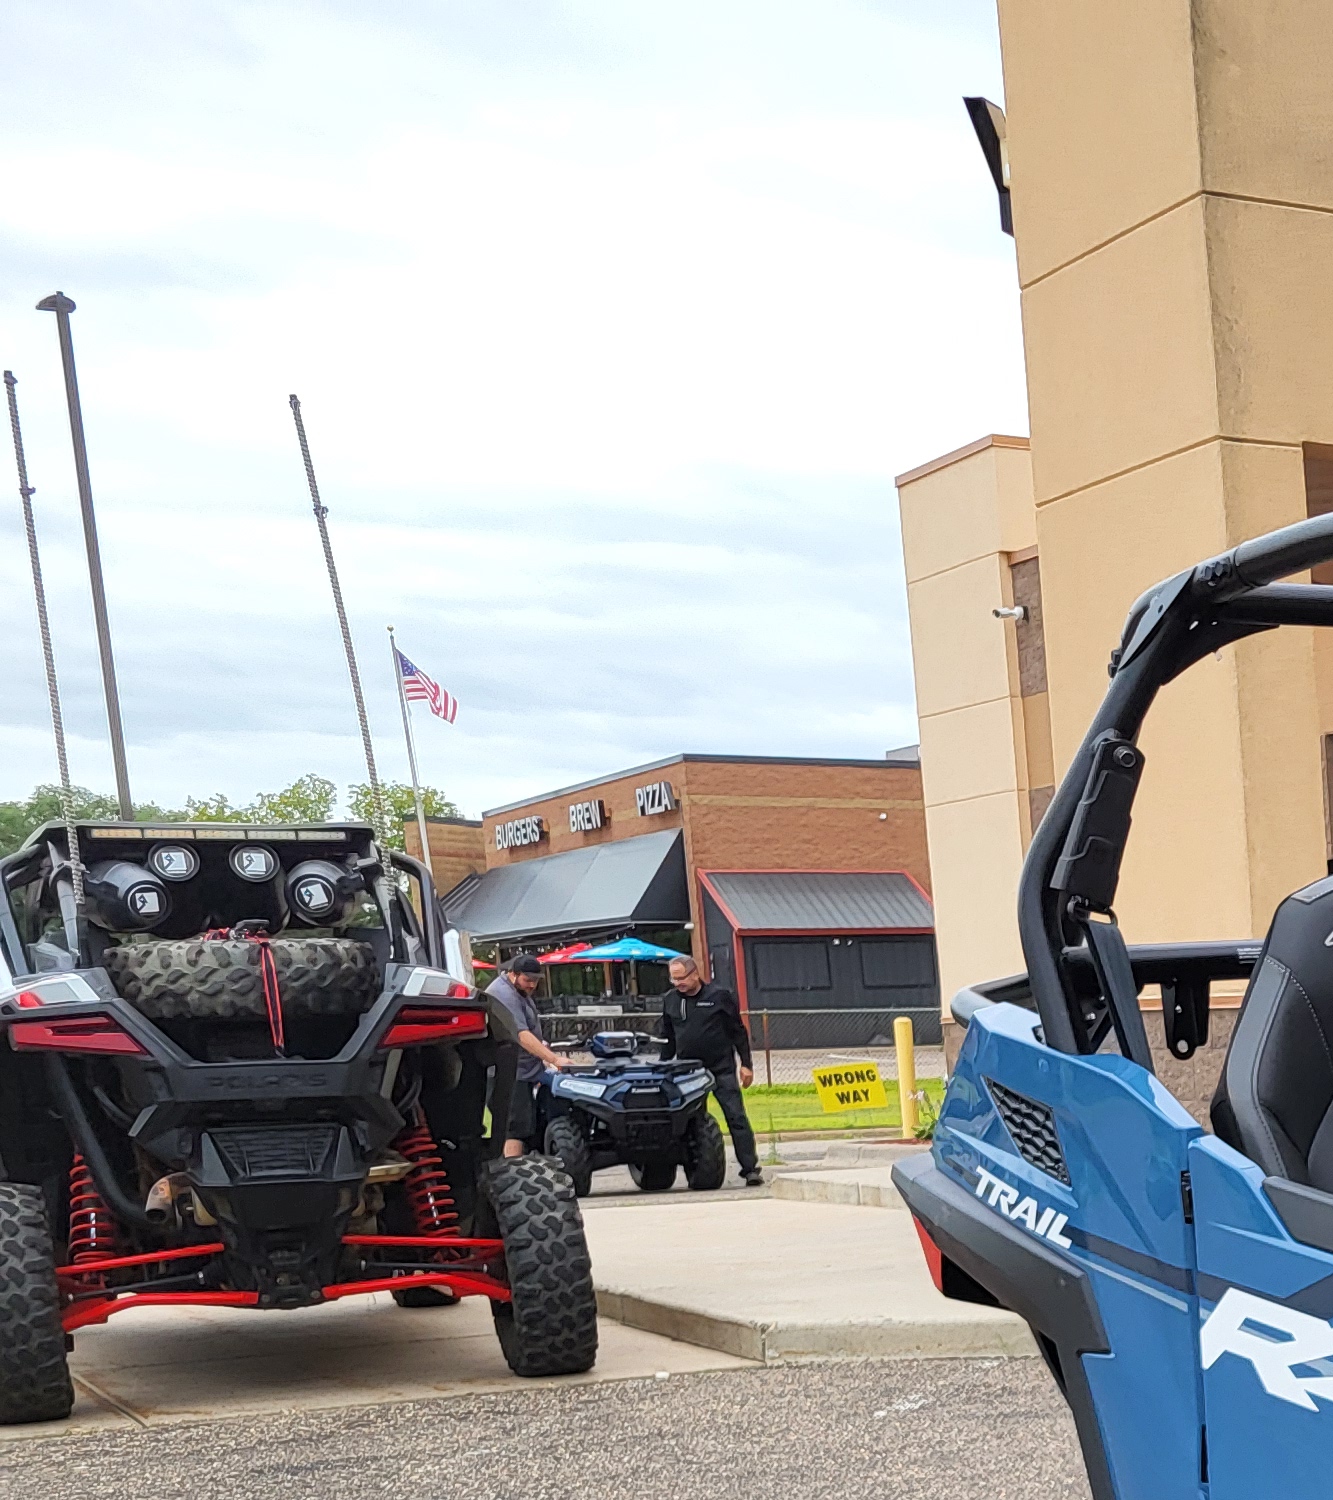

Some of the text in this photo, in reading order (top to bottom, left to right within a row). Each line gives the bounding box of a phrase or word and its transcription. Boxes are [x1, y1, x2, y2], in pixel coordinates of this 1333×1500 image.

[495, 781, 672, 850] BURGERS BREW PIZZA
[817, 1068, 877, 1088] WRONG
[835, 1088, 870, 1105] WAY
[975, 1164, 1073, 1250] TRAIL
